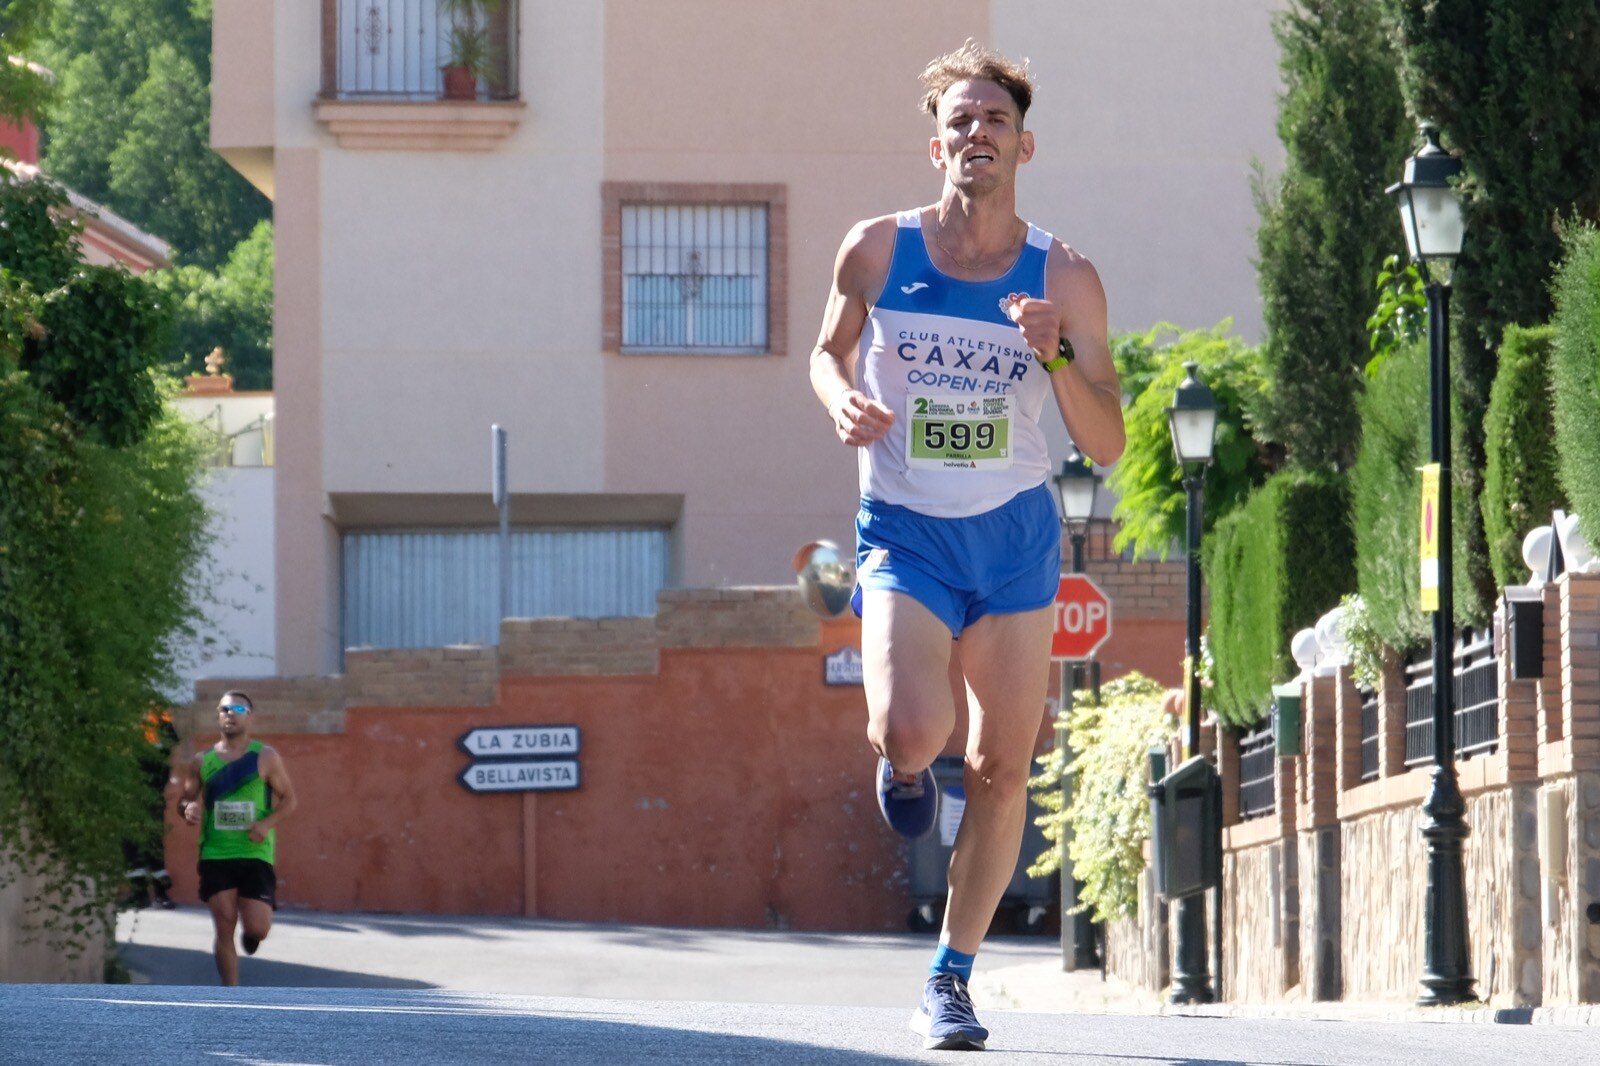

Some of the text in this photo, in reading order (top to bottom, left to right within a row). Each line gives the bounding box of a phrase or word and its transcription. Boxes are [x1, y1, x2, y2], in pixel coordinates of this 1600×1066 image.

[899, 331, 1032, 362] CLUB ATLETISMO
[897, 342, 1028, 381] CAXAR
[914, 397, 928, 414] 2
[924, 421, 995, 451] 599
[1053, 602, 1105, 634] TOP
[477, 733, 572, 749] LA ZUBIA
[476, 767, 572, 784] BELLAVISTA
[220, 812, 246, 823] 424
